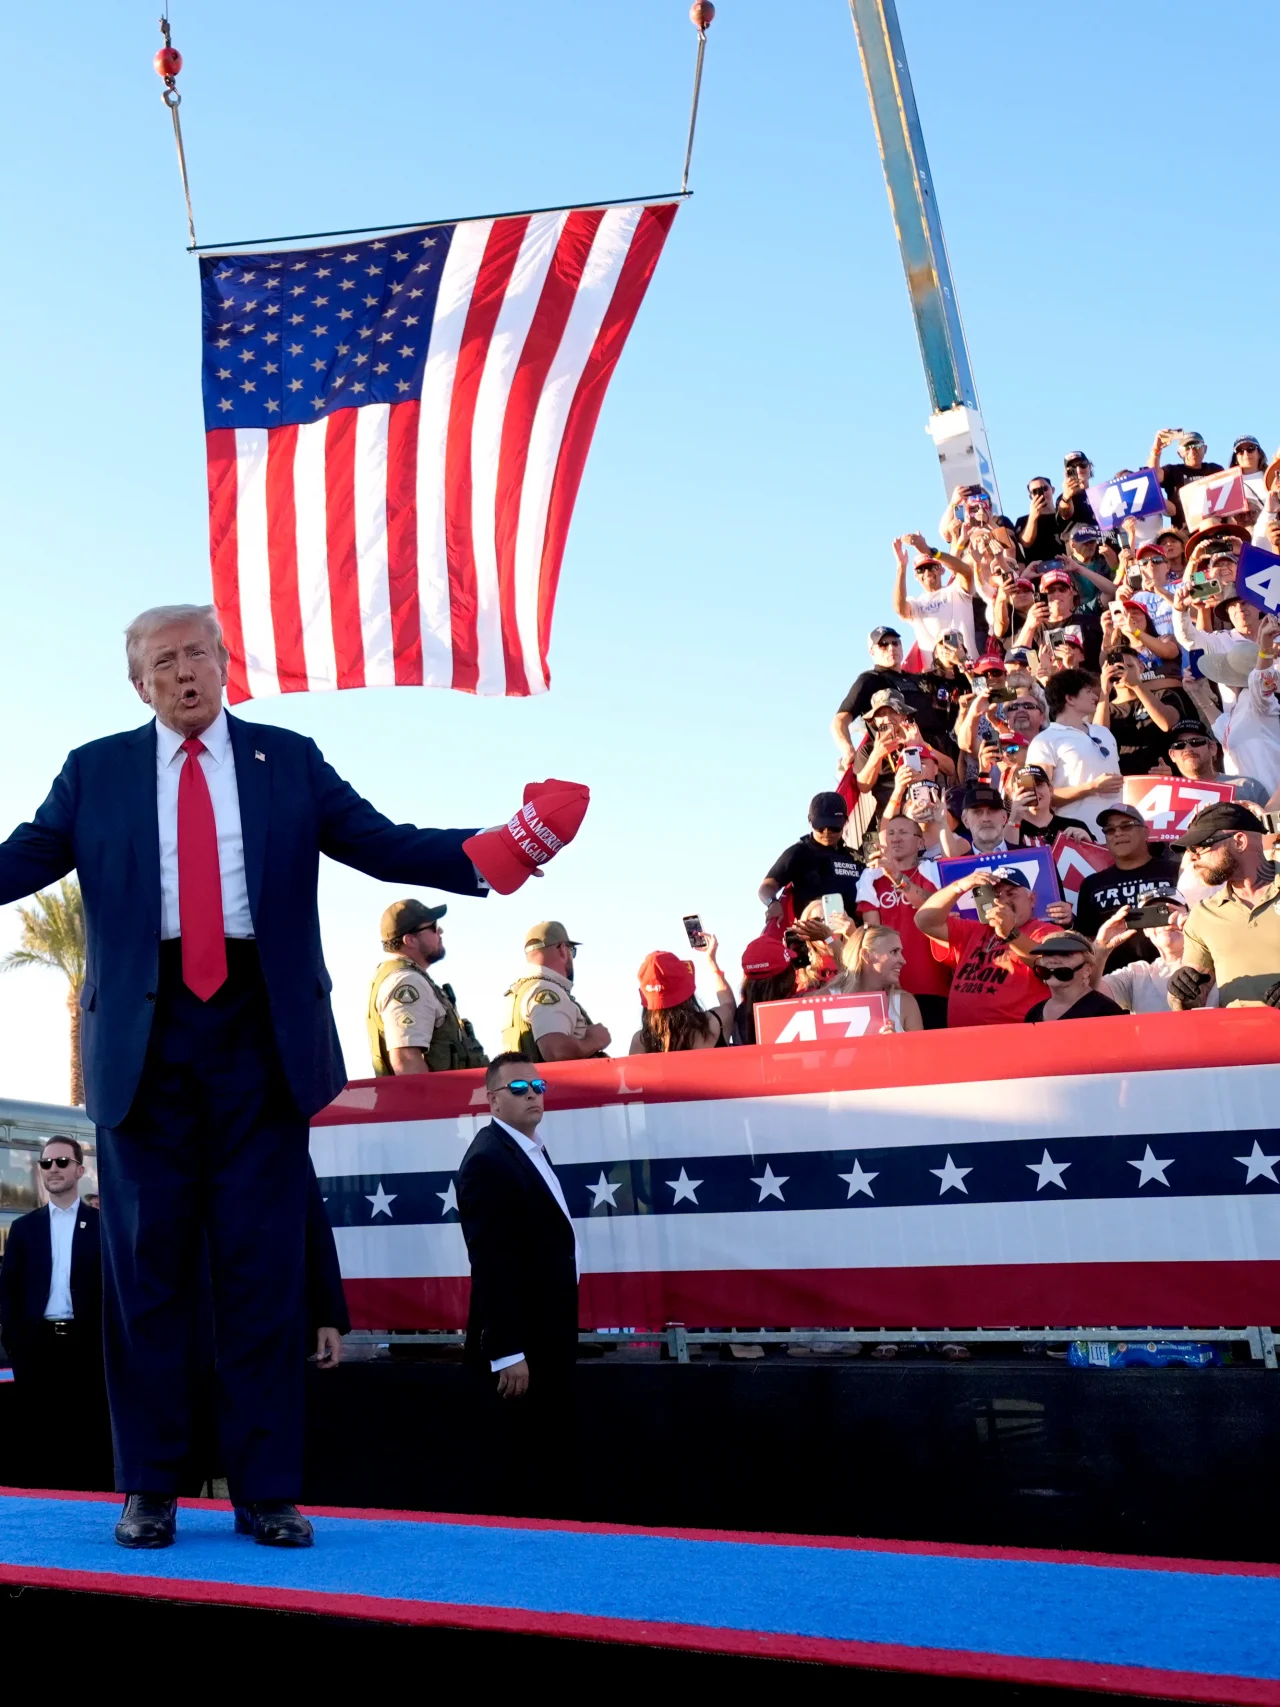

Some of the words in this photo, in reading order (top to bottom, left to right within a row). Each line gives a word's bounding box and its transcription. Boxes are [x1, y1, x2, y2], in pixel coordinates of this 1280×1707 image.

[1099, 476, 1150, 518] 47
[1245, 564, 1280, 611] 4
[1136, 784, 1221, 830] 47
[508, 815, 527, 841] REAT
[528, 817, 564, 852] AMERIC
[833, 861, 857, 870] SECRET
[834, 868, 859, 877] SERVICE
[1100, 897, 1135, 908] VAN
[774, 1006, 871, 1043] 47
[1090, 1346, 1108, 1361] LIFE
